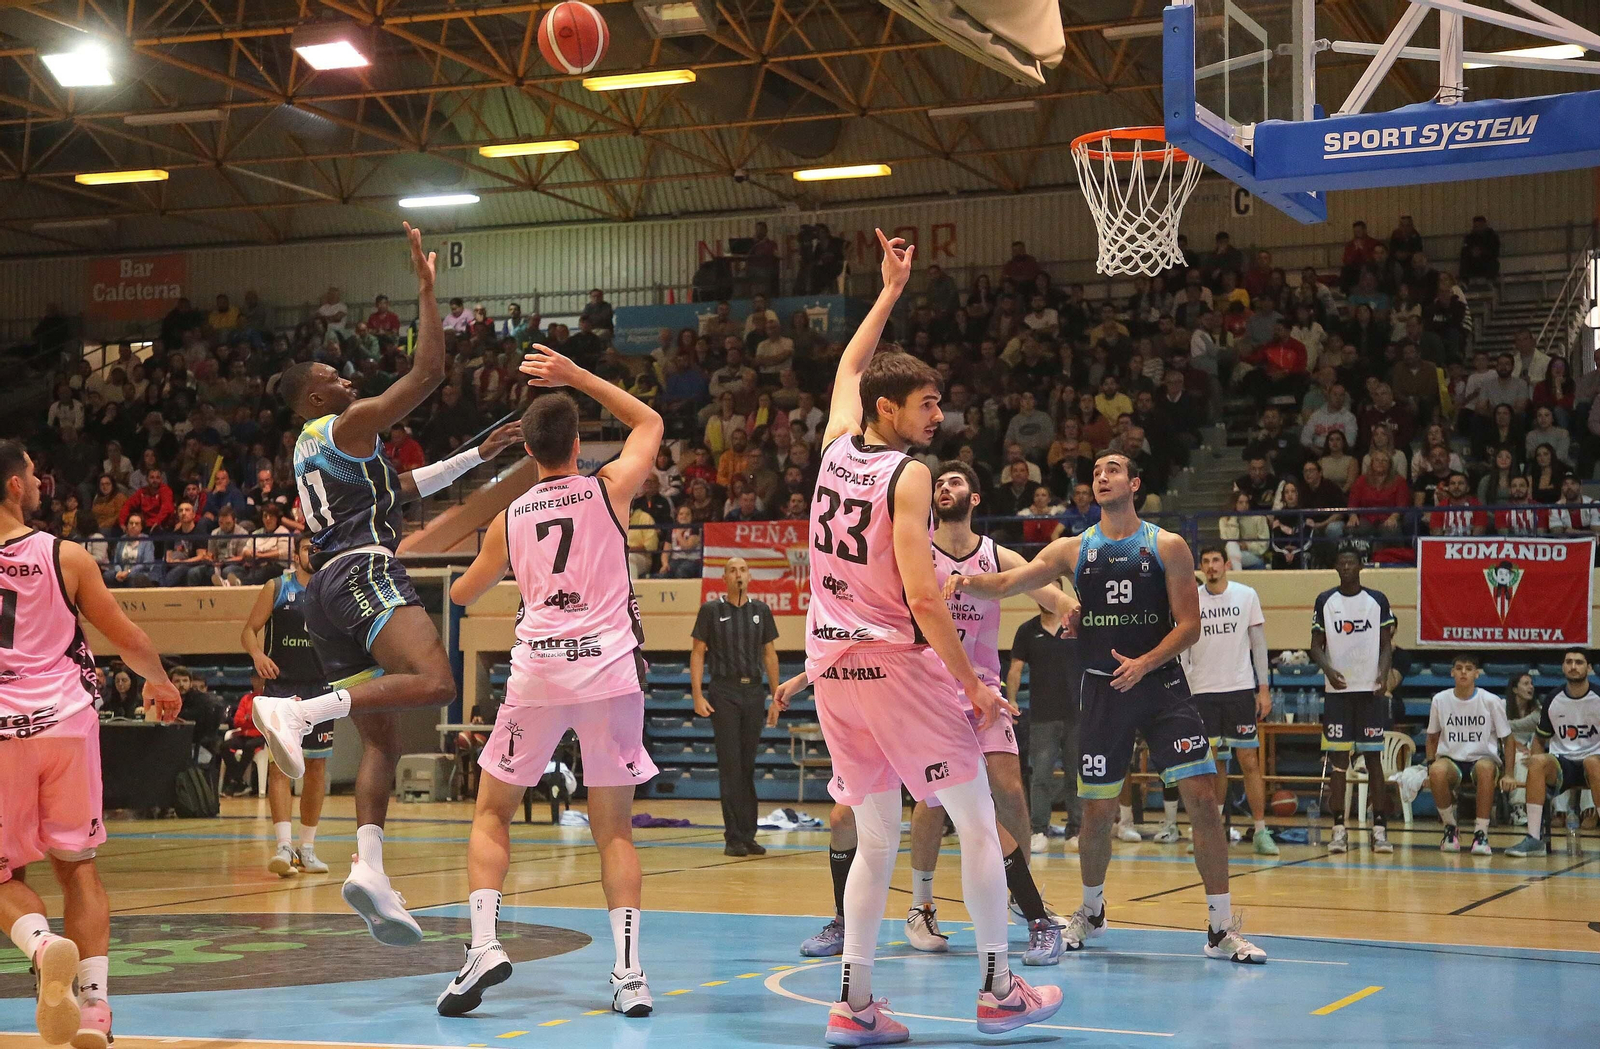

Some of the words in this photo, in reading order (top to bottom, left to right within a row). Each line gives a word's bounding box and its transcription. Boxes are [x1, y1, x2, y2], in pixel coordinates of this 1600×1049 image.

[1324, 126, 1417, 152] SPORT
[1419, 114, 1539, 150] SYSTEM
[1234, 187, 1251, 215] C
[449, 241, 463, 268] B
[120, 258, 154, 278] Bar
[826, 461, 878, 486] MORALES
[514, 490, 593, 517] HIERREZUELO
[734, 521, 799, 544] PEÑA
[814, 485, 873, 566] 33
[535, 517, 574, 575] 7
[1444, 542, 1568, 562] KOMANDO
[1105, 579, 1133, 604] 29
[196, 598, 216, 609] TV
[1200, 606, 1240, 619] ÁNIMO
[1082, 609, 1159, 627] damex.io
[1203, 622, 1238, 636] RILEY
[1442, 626, 1504, 640] FUENTE
[1507, 627, 1565, 641] NUEVA
[529, 650, 566, 659] Cmatización
[566, 647, 603, 662] gas
[1446, 713, 1486, 726] ÁNIMO
[1327, 724, 1343, 738] 35
[1448, 731, 1483, 743] RILEY
[1082, 754, 1107, 777] 29
